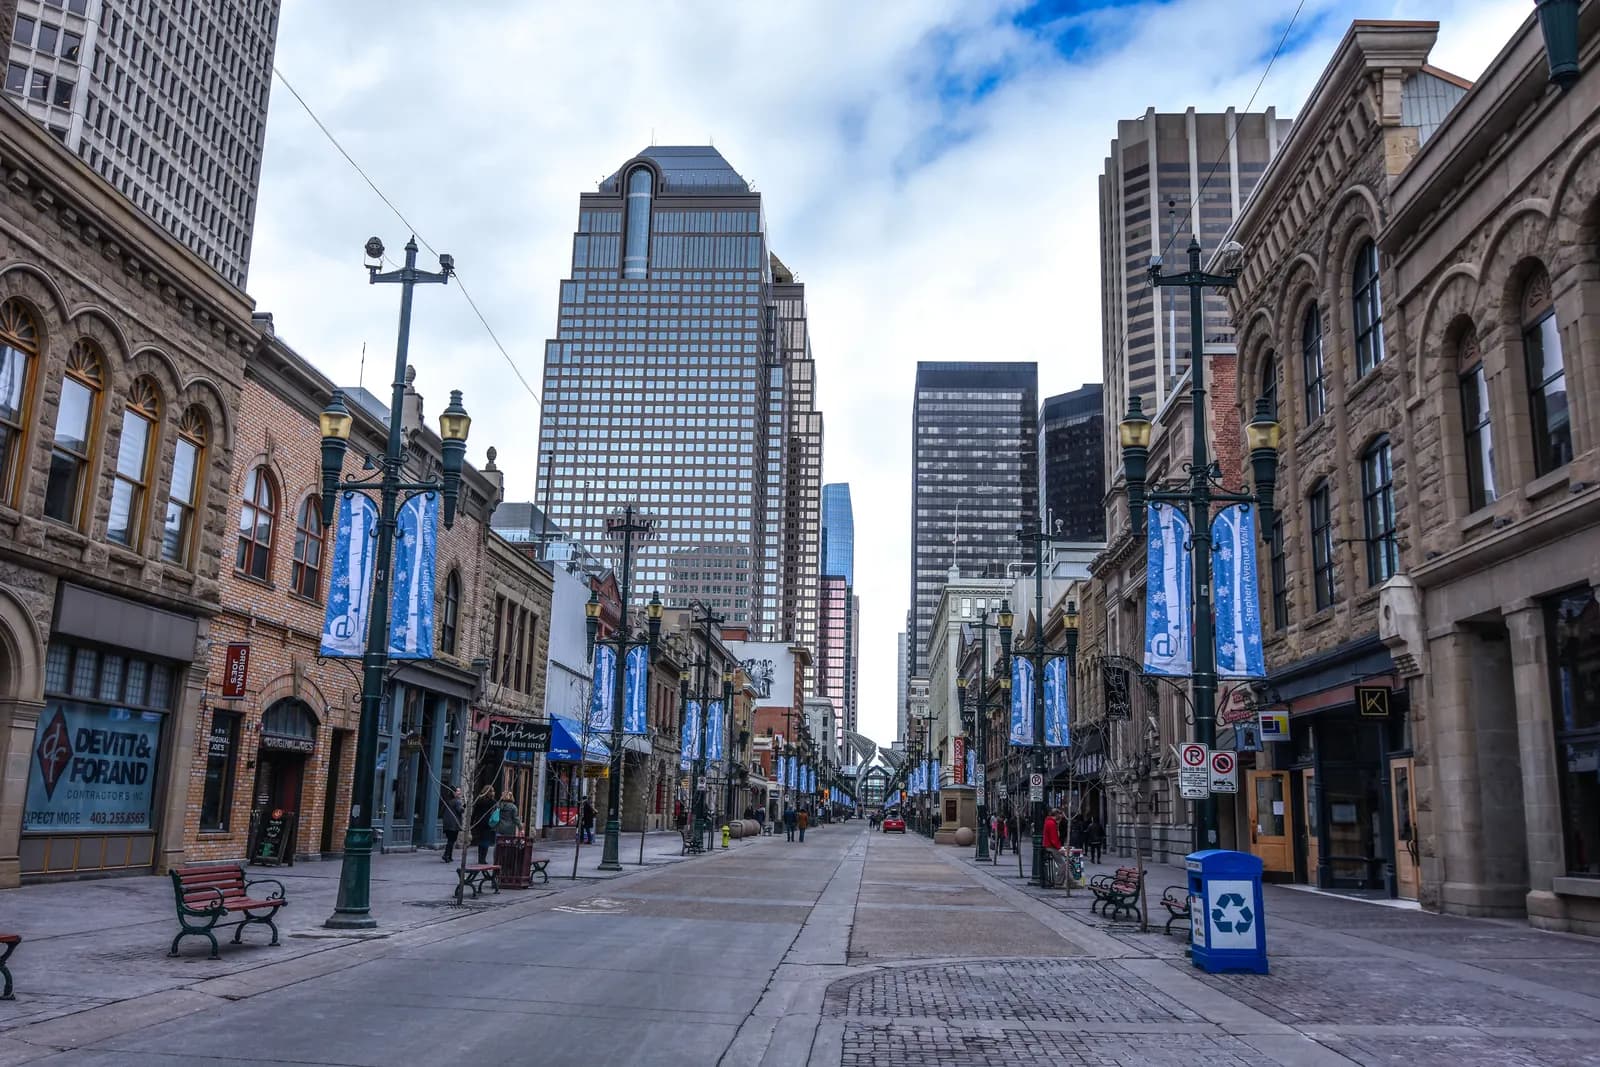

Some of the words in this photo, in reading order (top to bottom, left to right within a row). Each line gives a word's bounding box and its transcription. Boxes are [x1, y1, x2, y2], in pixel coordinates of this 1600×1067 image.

[423, 512, 432, 533] Walk
[1240, 525, 1249, 546] Walk
[422, 534, 431, 567] Avenue
[1242, 547, 1251, 583] Avenue
[421, 570, 431, 605] Stephen
[1245, 584, 1255, 622] Stephen
[236, 649, 247, 694] ORIGINAL
[69, 757, 148, 785] FORAND
[66, 789, 130, 801] CONTRACTORS
[57, 811, 81, 825] MORE
